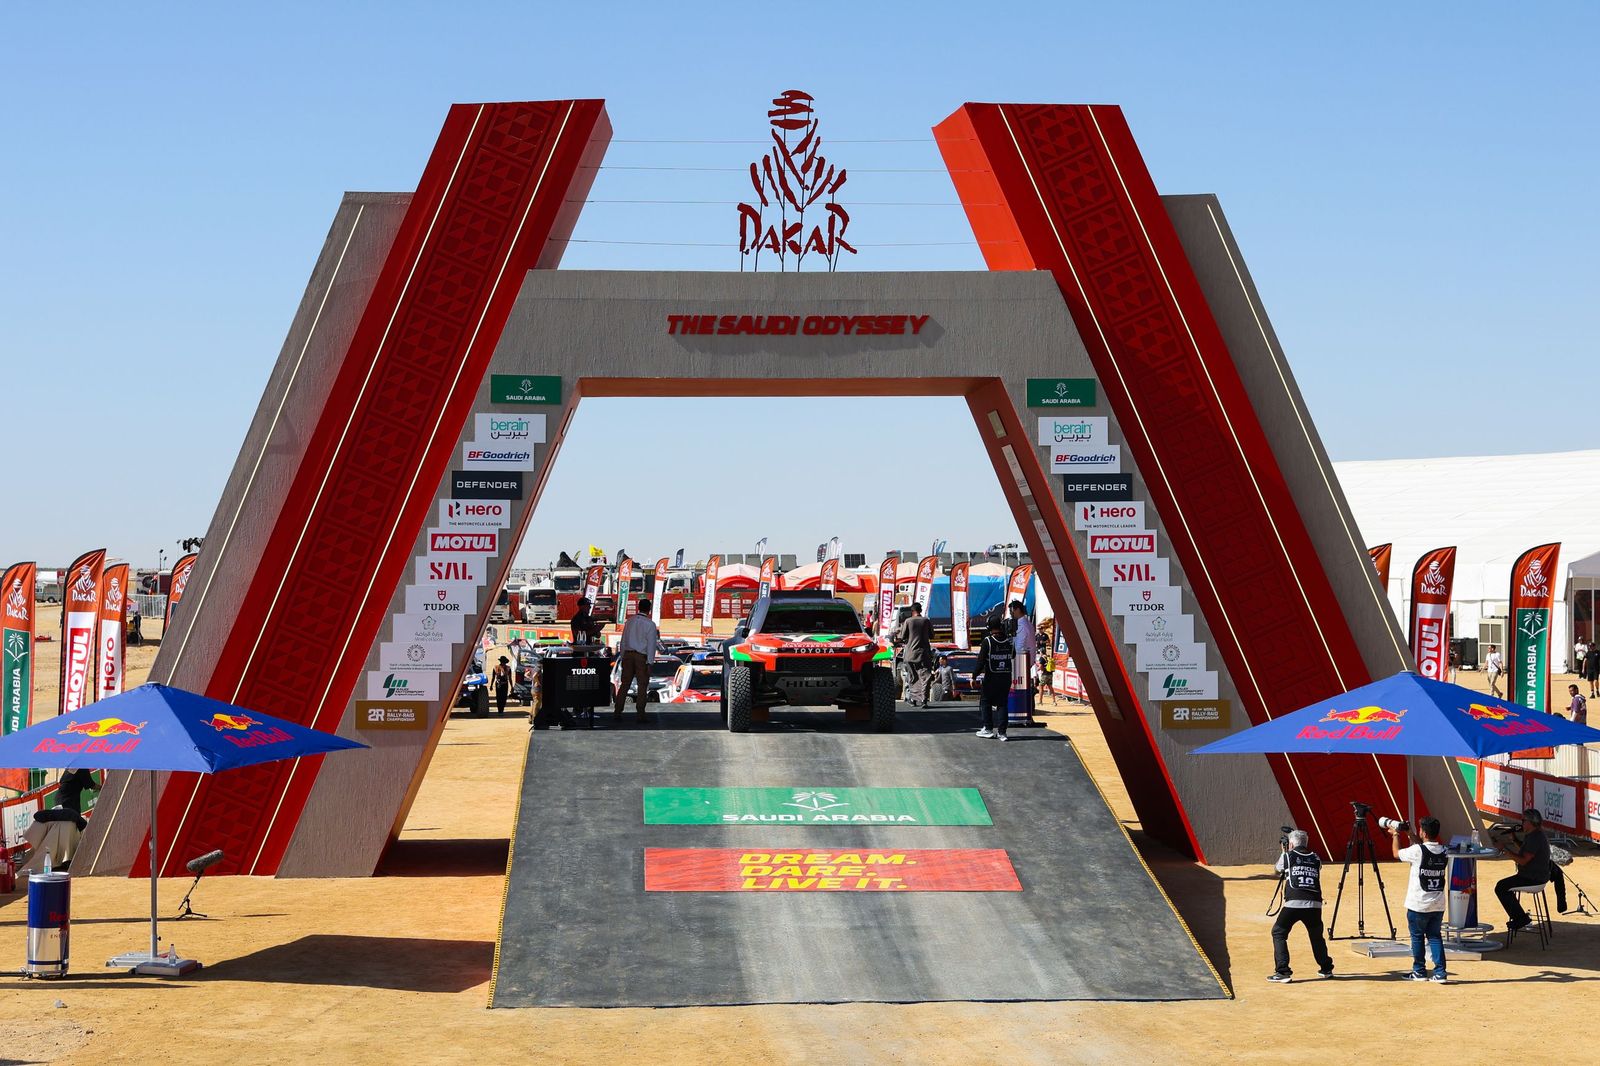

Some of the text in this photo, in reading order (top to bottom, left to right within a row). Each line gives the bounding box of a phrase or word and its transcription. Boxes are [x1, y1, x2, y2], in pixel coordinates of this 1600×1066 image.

[737, 203, 857, 255] DAKAR
[667, 315, 929, 335] THE SAUDI ODYSSEY
[490, 417, 529, 431] berain
[1054, 420, 1091, 434] berain
[490, 431, 528, 440] بيرين
[1054, 434, 1091, 443] بيرين
[468, 451, 530, 460] BFGoodrich
[1055, 454, 1115, 462] BFGoodrich
[456, 481, 517, 489] DEFENDER
[1068, 483, 1127, 491] DEFENDER
[465, 505, 502, 516] Hero
[1100, 507, 1136, 518] Hero
[434, 535, 493, 549] MOTUL
[1094, 537, 1151, 551] MOTUL
[1421, 582, 1447, 595] DAKAR
[1520, 585, 1549, 597] DAKAR
[72, 589, 97, 602] DAKAR
[6, 604, 29, 620] DAKAR
[423, 603, 460, 611] TUDOR
[882, 591, 892, 627] MOTUL
[1129, 603, 1164, 611] TUDOR
[1420, 622, 1439, 680] OTUL
[103, 637, 115, 691] Hero
[1527, 644, 1537, 688] ARABIA
[67, 632, 88, 712] MOTUL
[12, 668, 21, 713] ARABIA
[1296, 725, 1403, 740] Red Bull
[32, 738, 141, 753] Red Bull
[1544, 787, 1564, 808] berain
[722, 813, 917, 823] SAUDI ARABIA
[738, 853, 918, 865] DREAM.
[740, 865, 878, 876] DARE.
[1420, 868, 1440, 876] PODIUM
[741, 877, 907, 889] LIVE IT.
